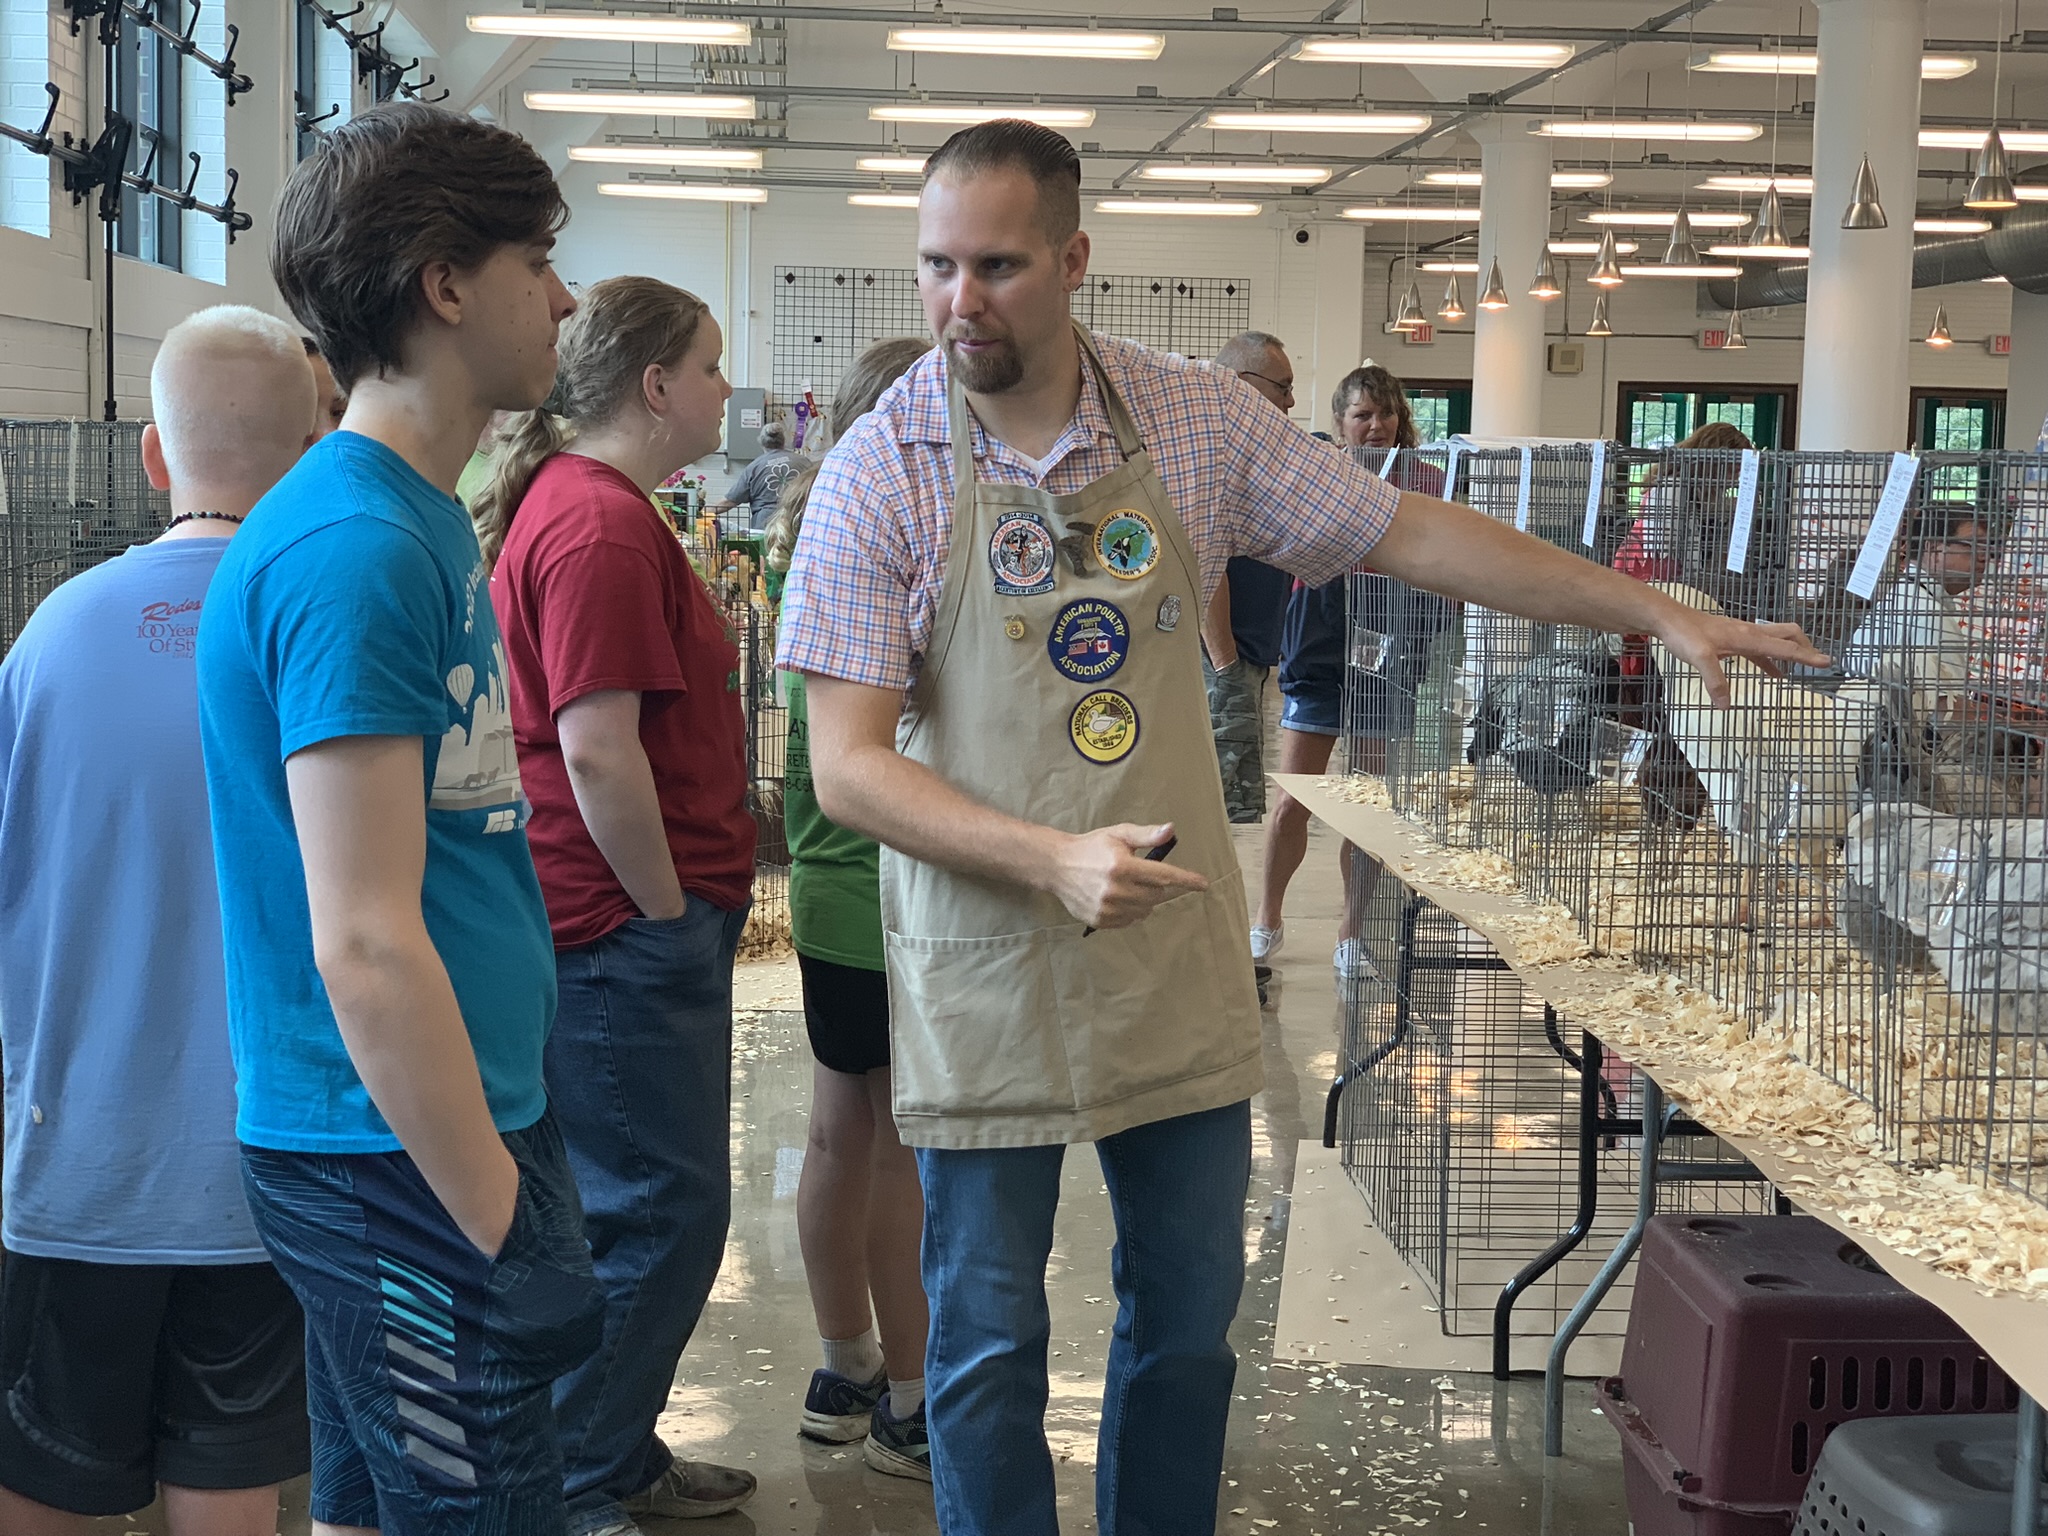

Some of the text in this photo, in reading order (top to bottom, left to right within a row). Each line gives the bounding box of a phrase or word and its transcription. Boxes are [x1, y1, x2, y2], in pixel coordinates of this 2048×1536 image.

[1704, 331, 1725, 346] EXIT
[1996, 336, 2010, 351] EXI
[993, 521, 1051, 549] AMERICAN BANTAM
[1097, 512, 1155, 555] INTERNATIONAL WATERFOWL
[1001, 569, 1045, 585] ASSOCIATION
[1107, 564, 1141, 575] BREEDER'S
[136, 624, 165, 638] 100
[1054, 603, 1126, 643] AMERICAN POULTRY
[149, 638, 172, 653] Of
[1059, 651, 1121, 675] ASSOCIATION
[1075, 695, 1133, 736] NATIONAL CALL BREEDERS
